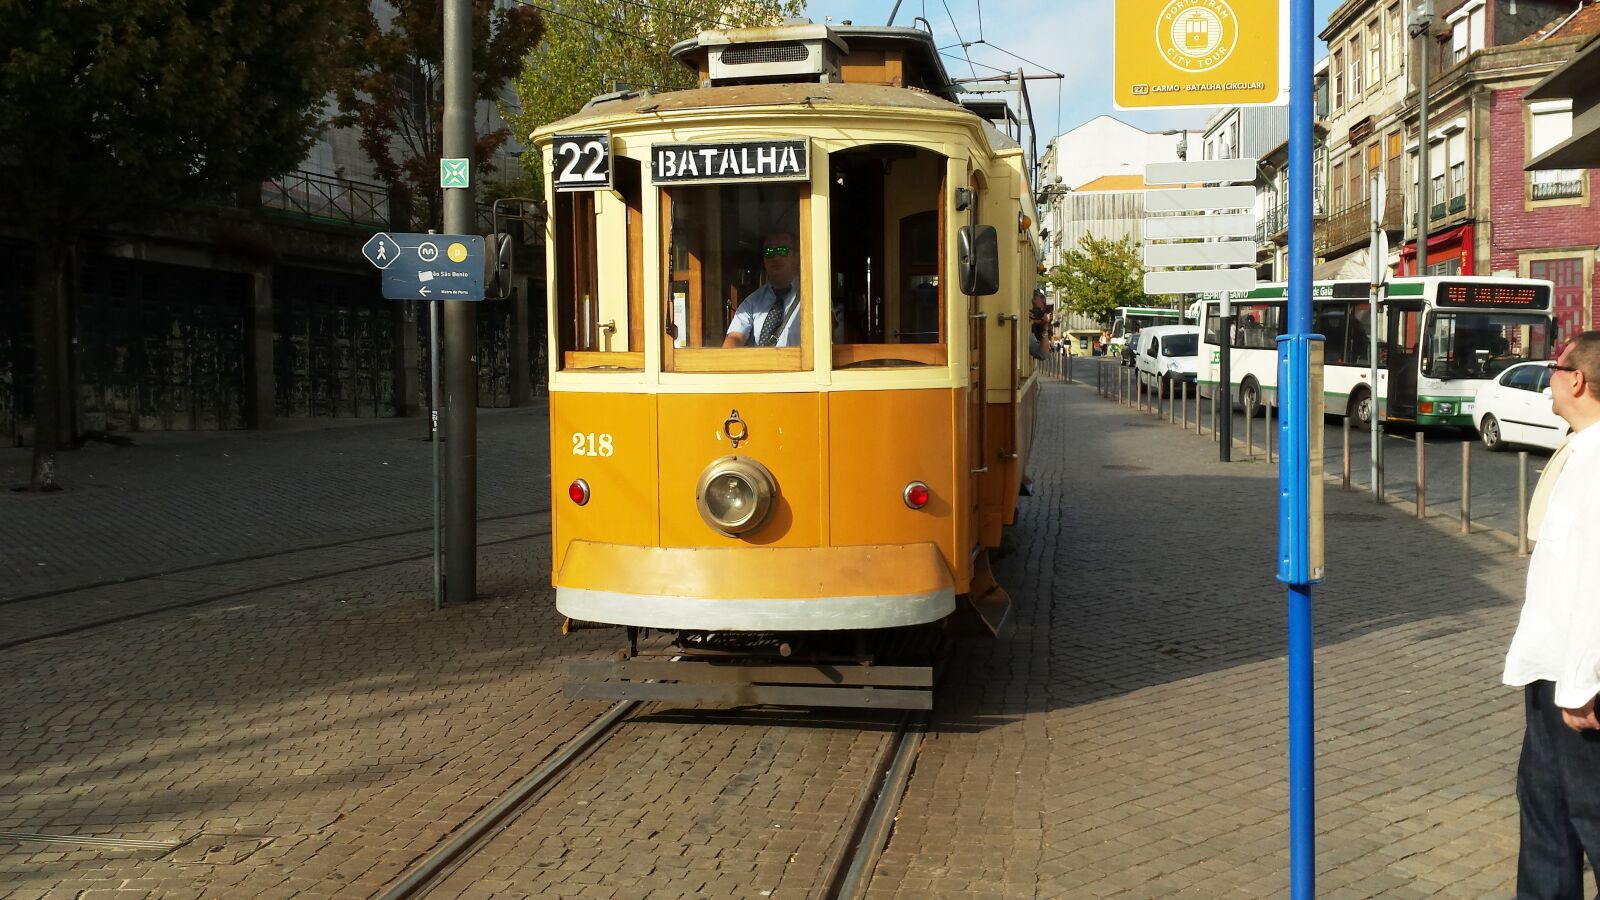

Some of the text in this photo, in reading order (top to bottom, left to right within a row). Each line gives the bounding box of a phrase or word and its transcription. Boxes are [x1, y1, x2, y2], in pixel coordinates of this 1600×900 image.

[1167, 46, 1227, 68] CITY TOUR
[1151, 84, 1180, 93] CARMO
[1186, 83, 1221, 92] BATALHA
[1223, 81, 1265, 91] (CIRCULAR)
[559, 141, 607, 183] 22
[657, 146, 800, 177] BATALHA
[1320, 286, 1334, 296] Gaia
[572, 432, 614, 457] 218
